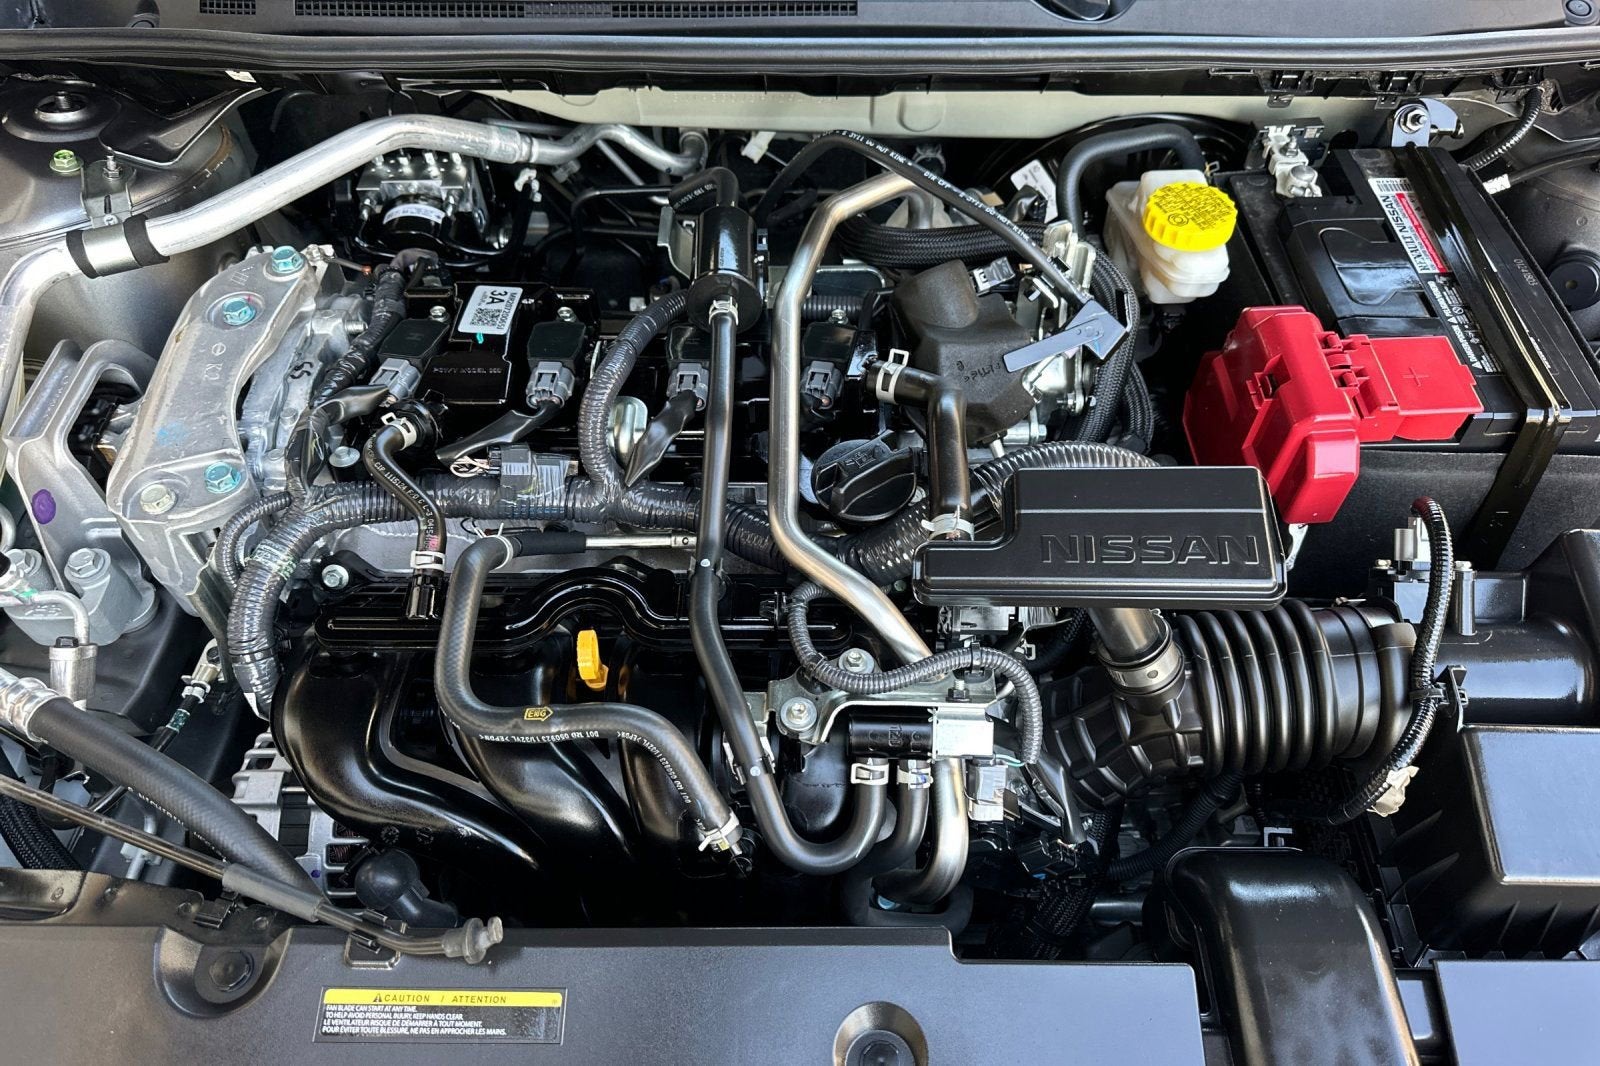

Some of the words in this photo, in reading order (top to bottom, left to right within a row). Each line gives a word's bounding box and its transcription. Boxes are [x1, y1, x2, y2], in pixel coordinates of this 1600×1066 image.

[889, 151, 907, 164] KINK
[1380, 195, 1410, 233] NISSAN
[1012, 225, 1030, 242] KINK
[1401, 234, 1431, 272] RENAULT
[485, 289, 509, 305] 3A
[1040, 534, 1260, 565] NISSAN
[526, 709, 547, 718] ENG
[384, 994, 431, 1003] CAUTION
[451, 995, 507, 1004] ATTENTION
